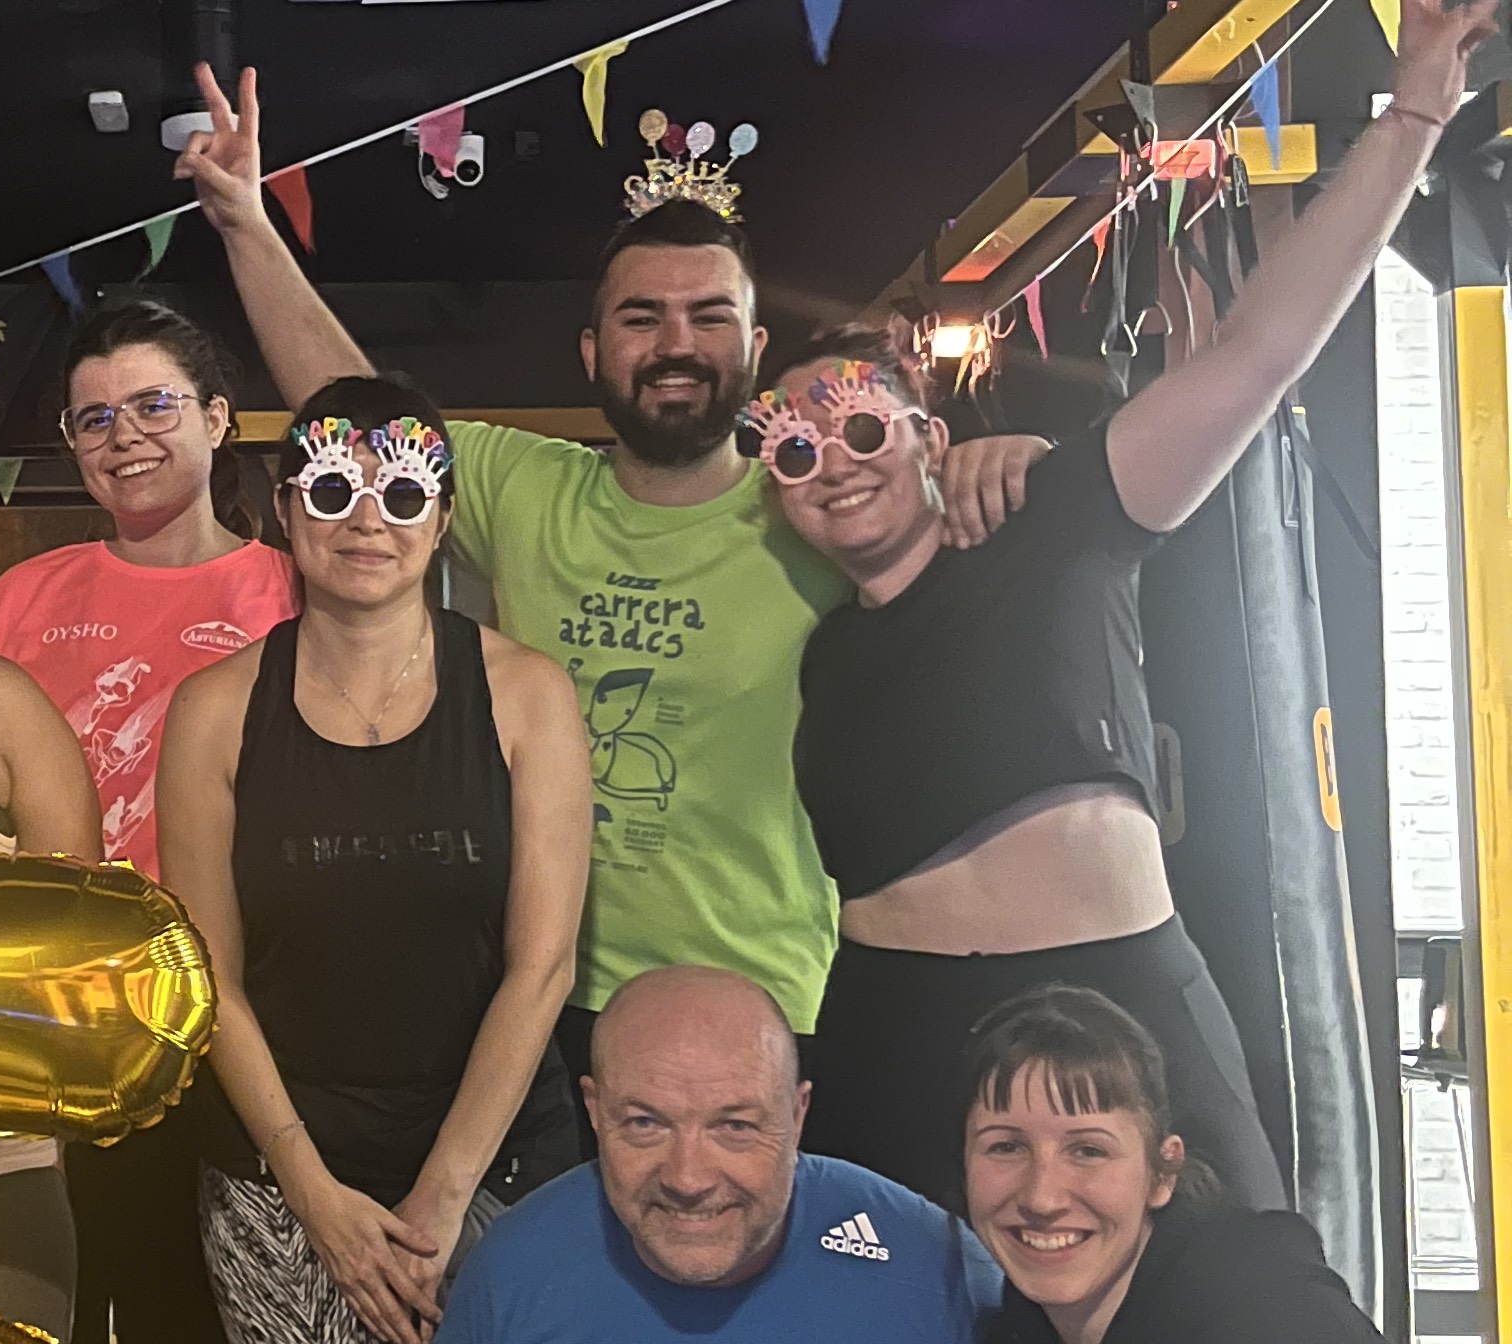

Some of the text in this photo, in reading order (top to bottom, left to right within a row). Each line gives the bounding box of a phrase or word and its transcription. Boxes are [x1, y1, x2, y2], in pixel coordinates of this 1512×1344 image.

[291, 417, 363, 446] HAPPY
[580, 592, 706, 630] carrera
[42, 623, 118, 644] OYSHO
[559, 617, 683, 659] atades
[820, 1235, 890, 1261] adidas
